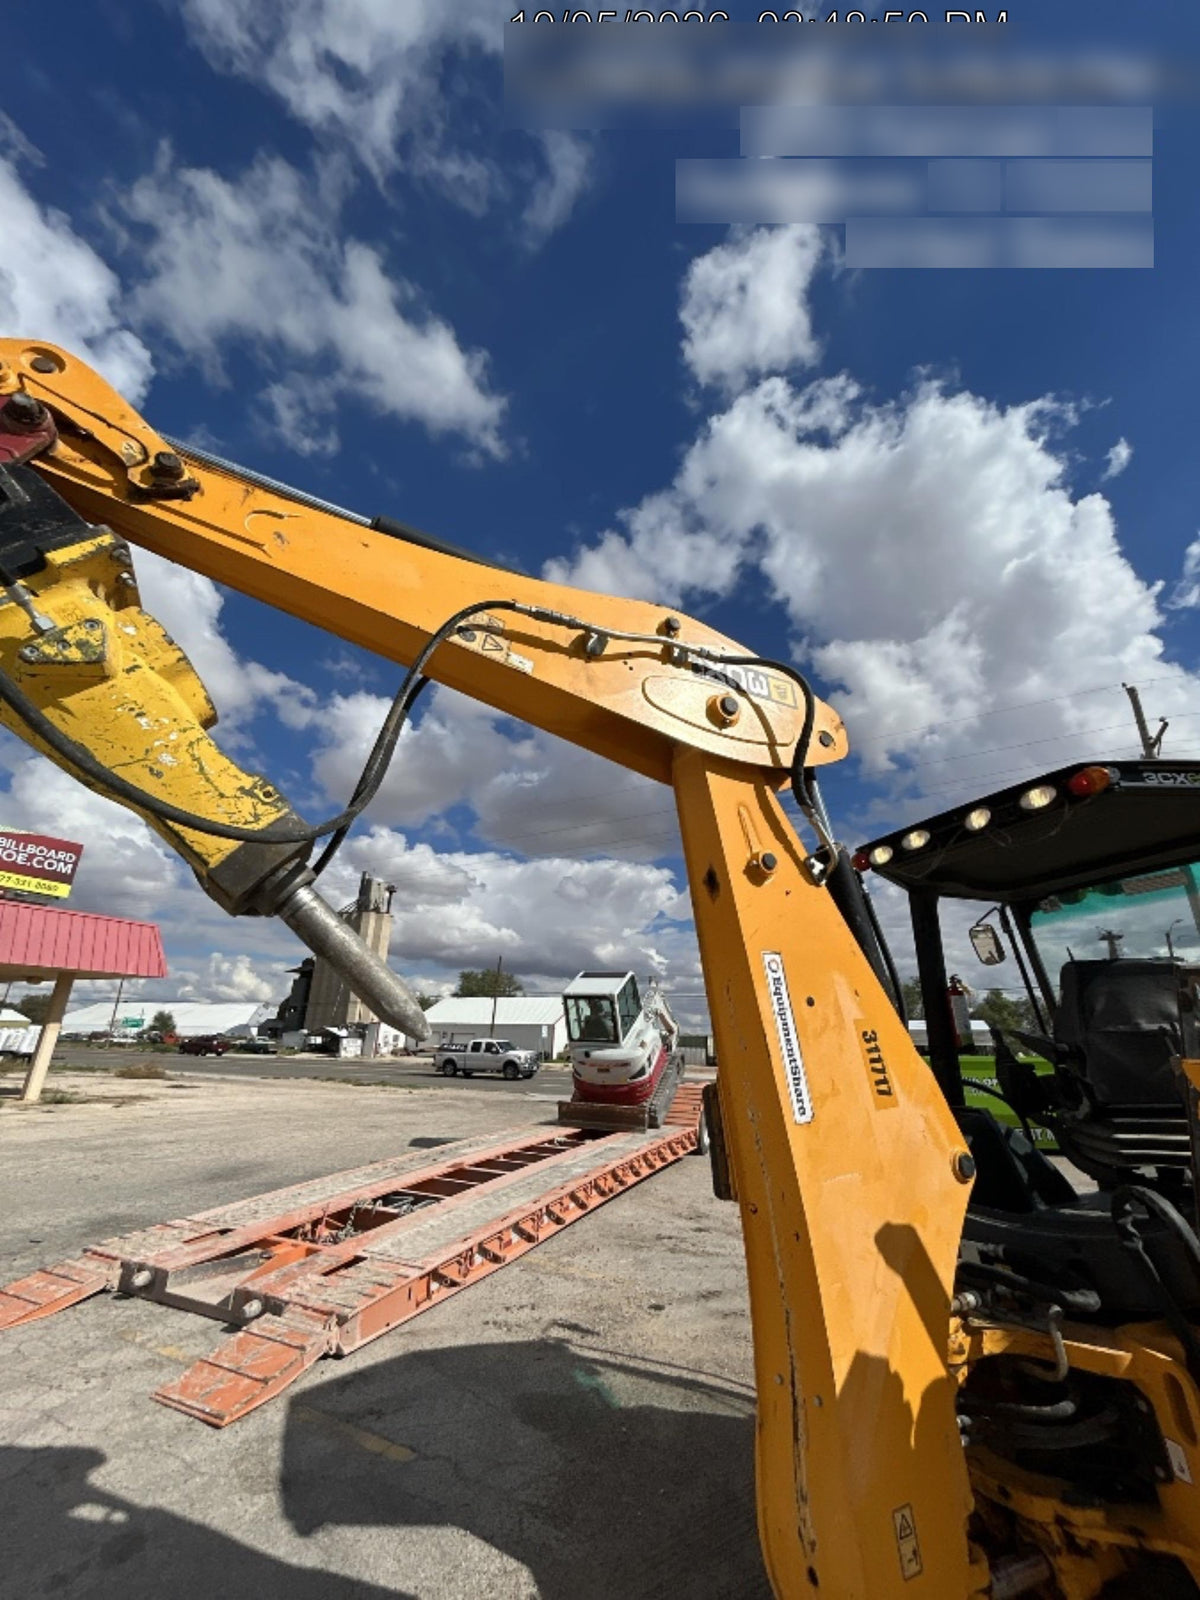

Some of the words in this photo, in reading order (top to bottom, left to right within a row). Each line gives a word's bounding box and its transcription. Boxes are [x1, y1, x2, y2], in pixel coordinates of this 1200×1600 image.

[0, 837, 76, 862] BILLBOARD
[771, 976, 807, 1117] EquipmentShare
[862, 1029, 893, 1097] 311717
